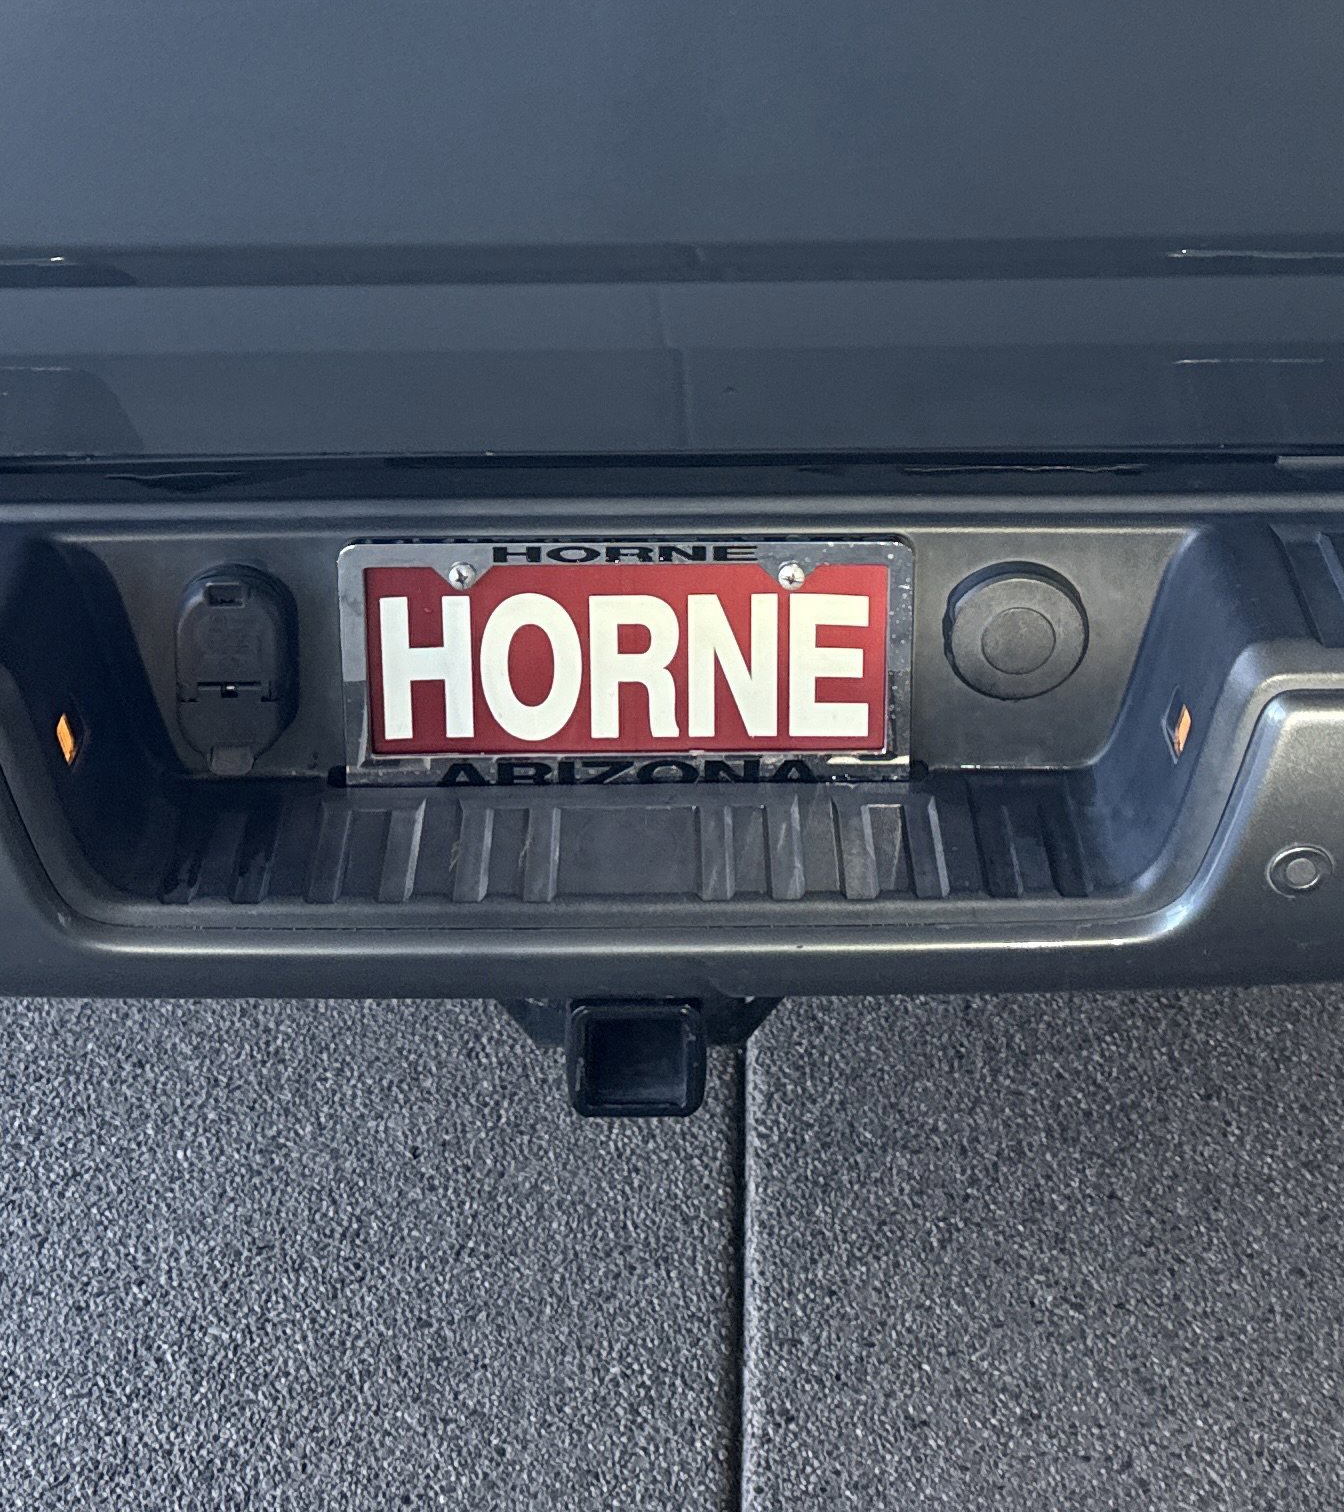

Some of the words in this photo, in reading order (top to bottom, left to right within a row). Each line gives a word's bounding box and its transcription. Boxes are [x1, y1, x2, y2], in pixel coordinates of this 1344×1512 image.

[491, 545, 759, 564] HORNE
[378, 591, 870, 742] HORNE
[437, 759, 817, 786] ARIZONA
